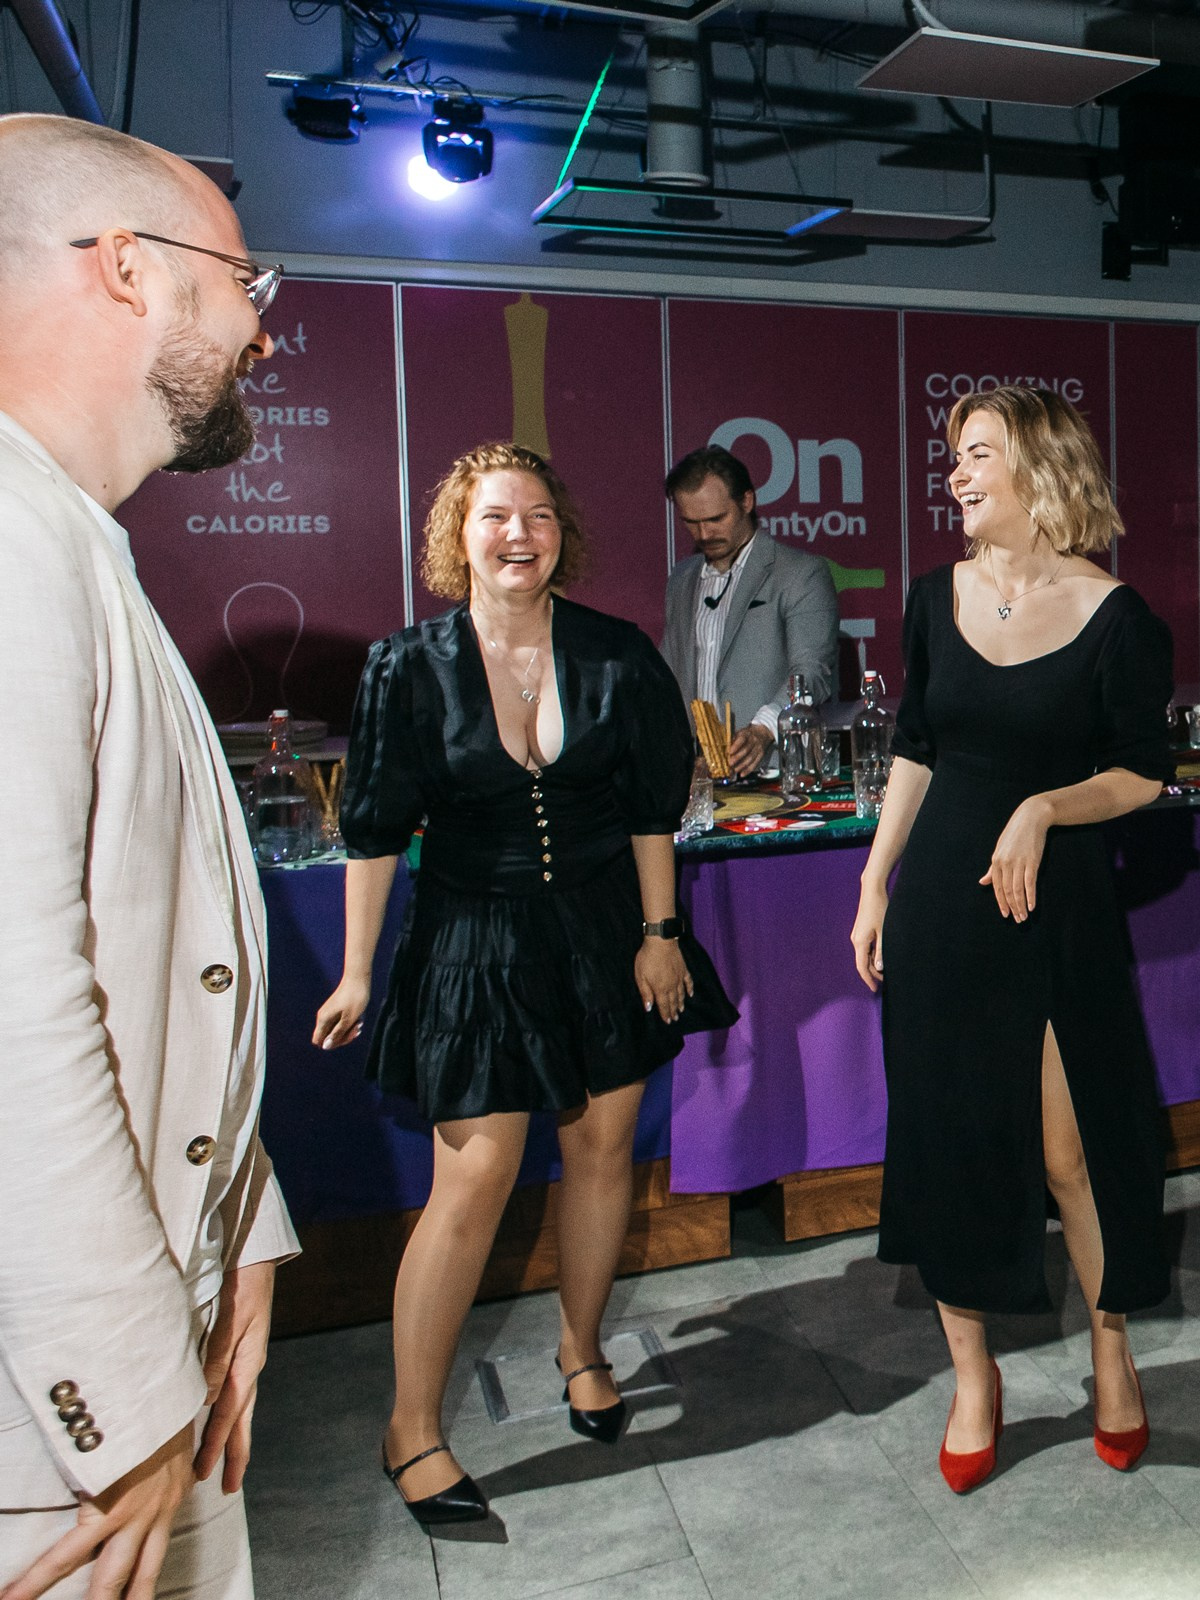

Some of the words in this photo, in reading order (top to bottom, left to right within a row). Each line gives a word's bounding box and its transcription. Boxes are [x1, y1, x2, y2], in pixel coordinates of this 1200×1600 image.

[274, 322, 308, 354] nt
[247, 406, 331, 426] ORIES
[241, 432, 285, 464] ot
[707, 417, 863, 506] On
[224, 471, 291, 502] the
[186, 514, 331, 534] CALORIES
